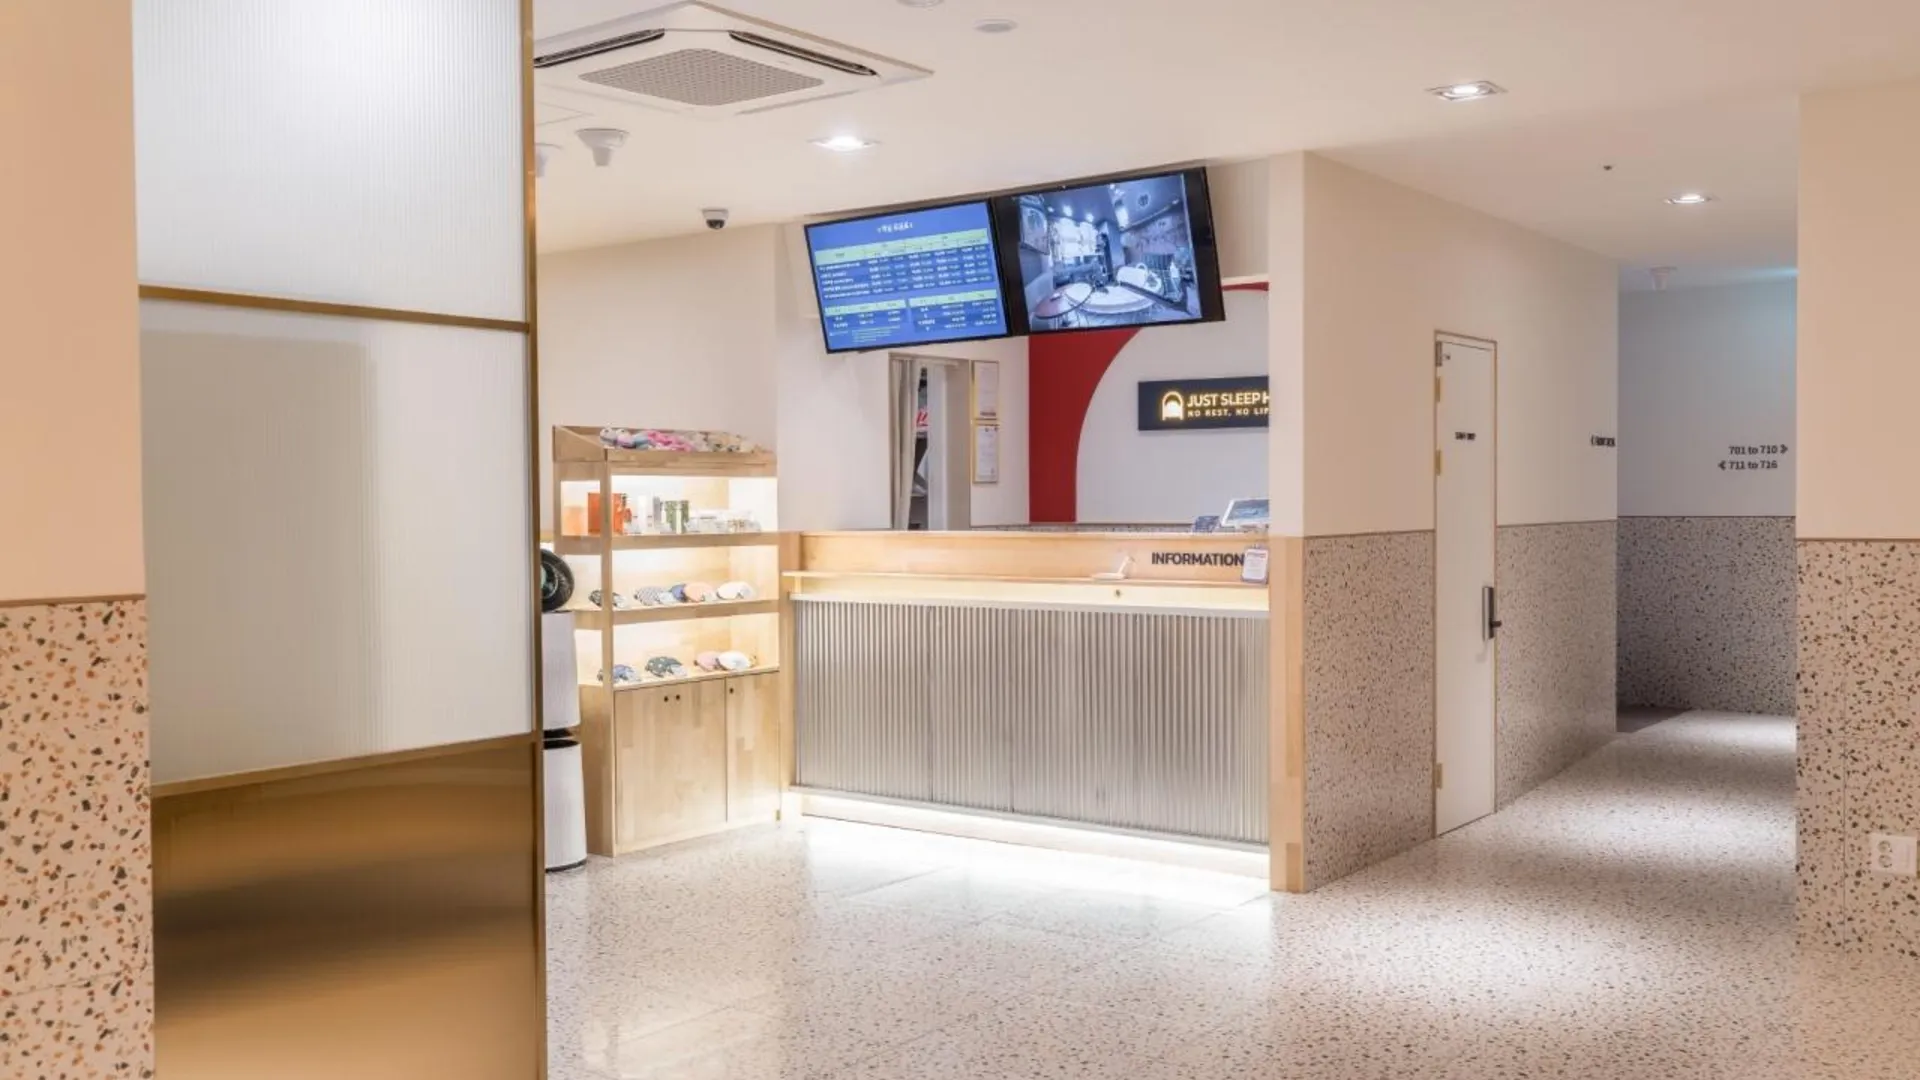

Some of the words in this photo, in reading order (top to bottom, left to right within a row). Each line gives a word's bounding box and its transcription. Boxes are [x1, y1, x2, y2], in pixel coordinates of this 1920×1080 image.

[1187, 393, 1218, 408] JUST
[1220, 391, 1260, 406] SLEEP
[1187, 409, 1201, 418] NO
[1205, 408, 1233, 417] REST,
[1235, 407, 1249, 417] NO
[1728, 446, 1746, 455] 701
[1748, 446, 1759, 455] to
[1760, 444, 1778, 454] 710
[1728, 461, 1746, 470] 711
[1748, 461, 1759, 469] to
[1151, 552, 1245, 567] INFORMATION
